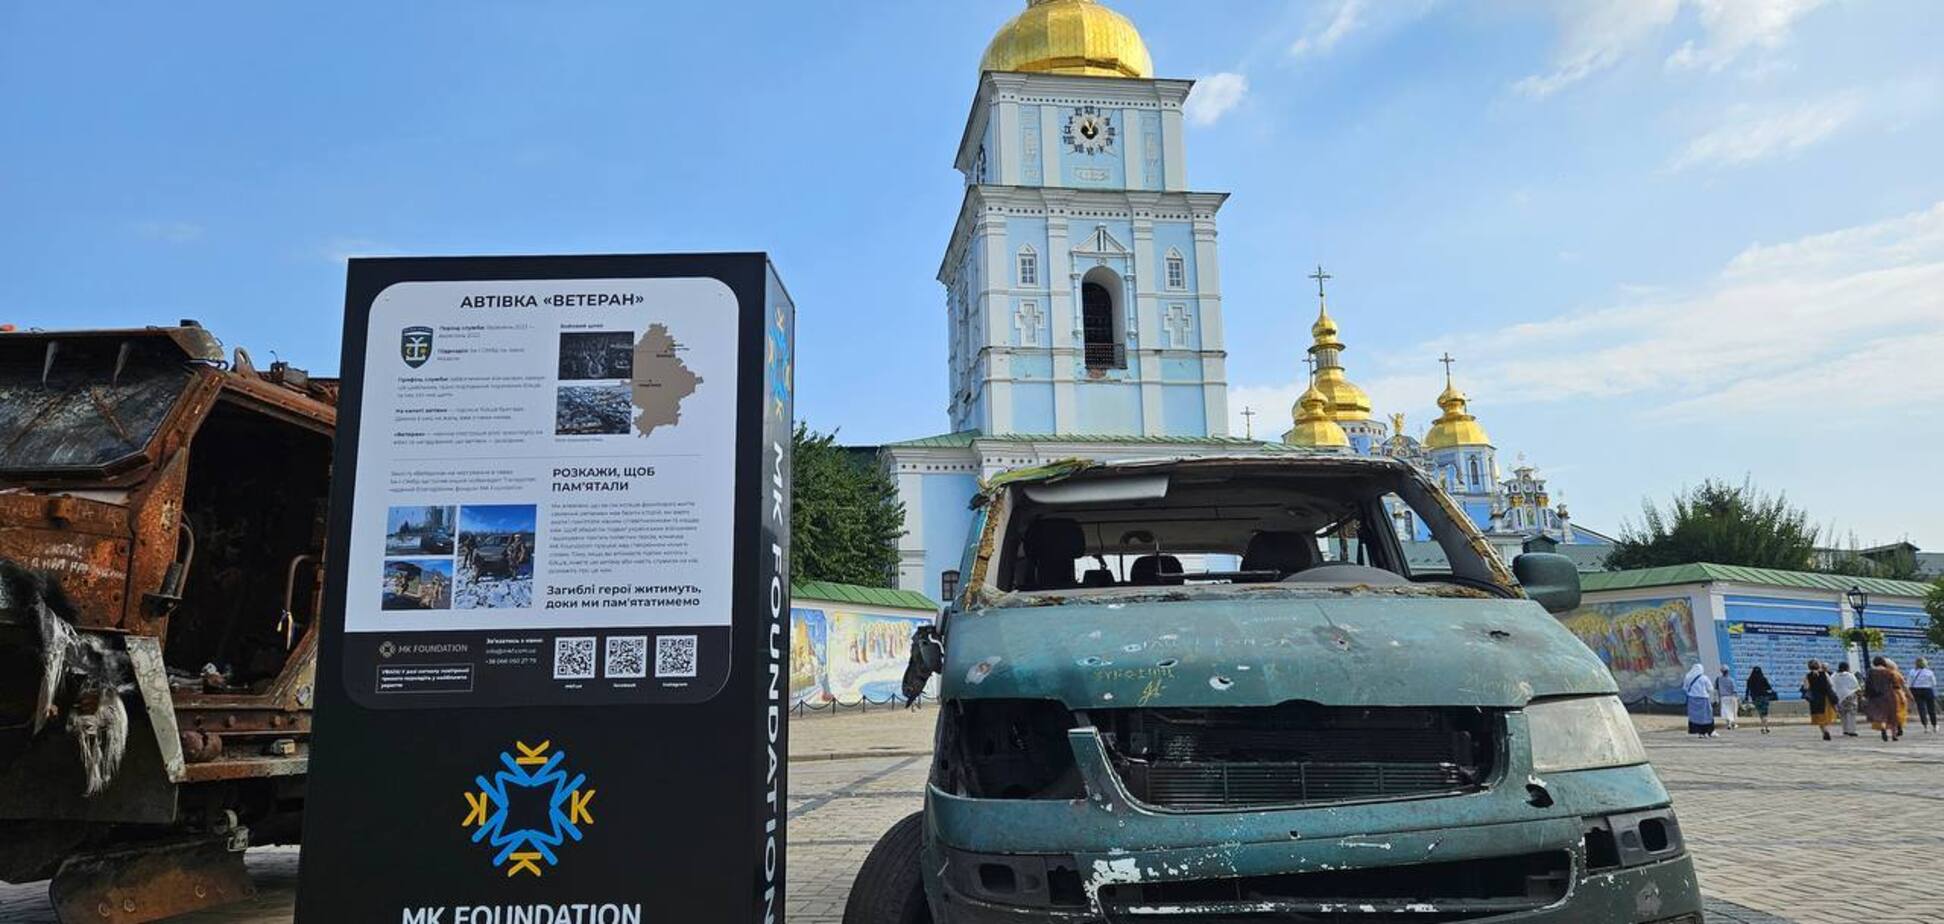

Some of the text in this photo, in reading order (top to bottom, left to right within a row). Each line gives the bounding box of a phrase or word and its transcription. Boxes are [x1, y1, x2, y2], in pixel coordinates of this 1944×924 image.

[460, 293, 645, 309] АВТІВКА «ВЕТЕРАН»
[552, 466, 656, 480] РОЗКАЖИ, ЩОБ
[551, 480, 629, 492] ПАМ'ЯТАЛИ
[546, 584, 702, 598] Загиблі герої житимуть,
[545, 596, 700, 610] доки ми пам'ятатимемо
[398, 643, 468, 653] MK FOUNDATION
[763, 442, 784, 924] MK FOUNDATION
[402, 904, 642, 924] MK FOUNDATION
